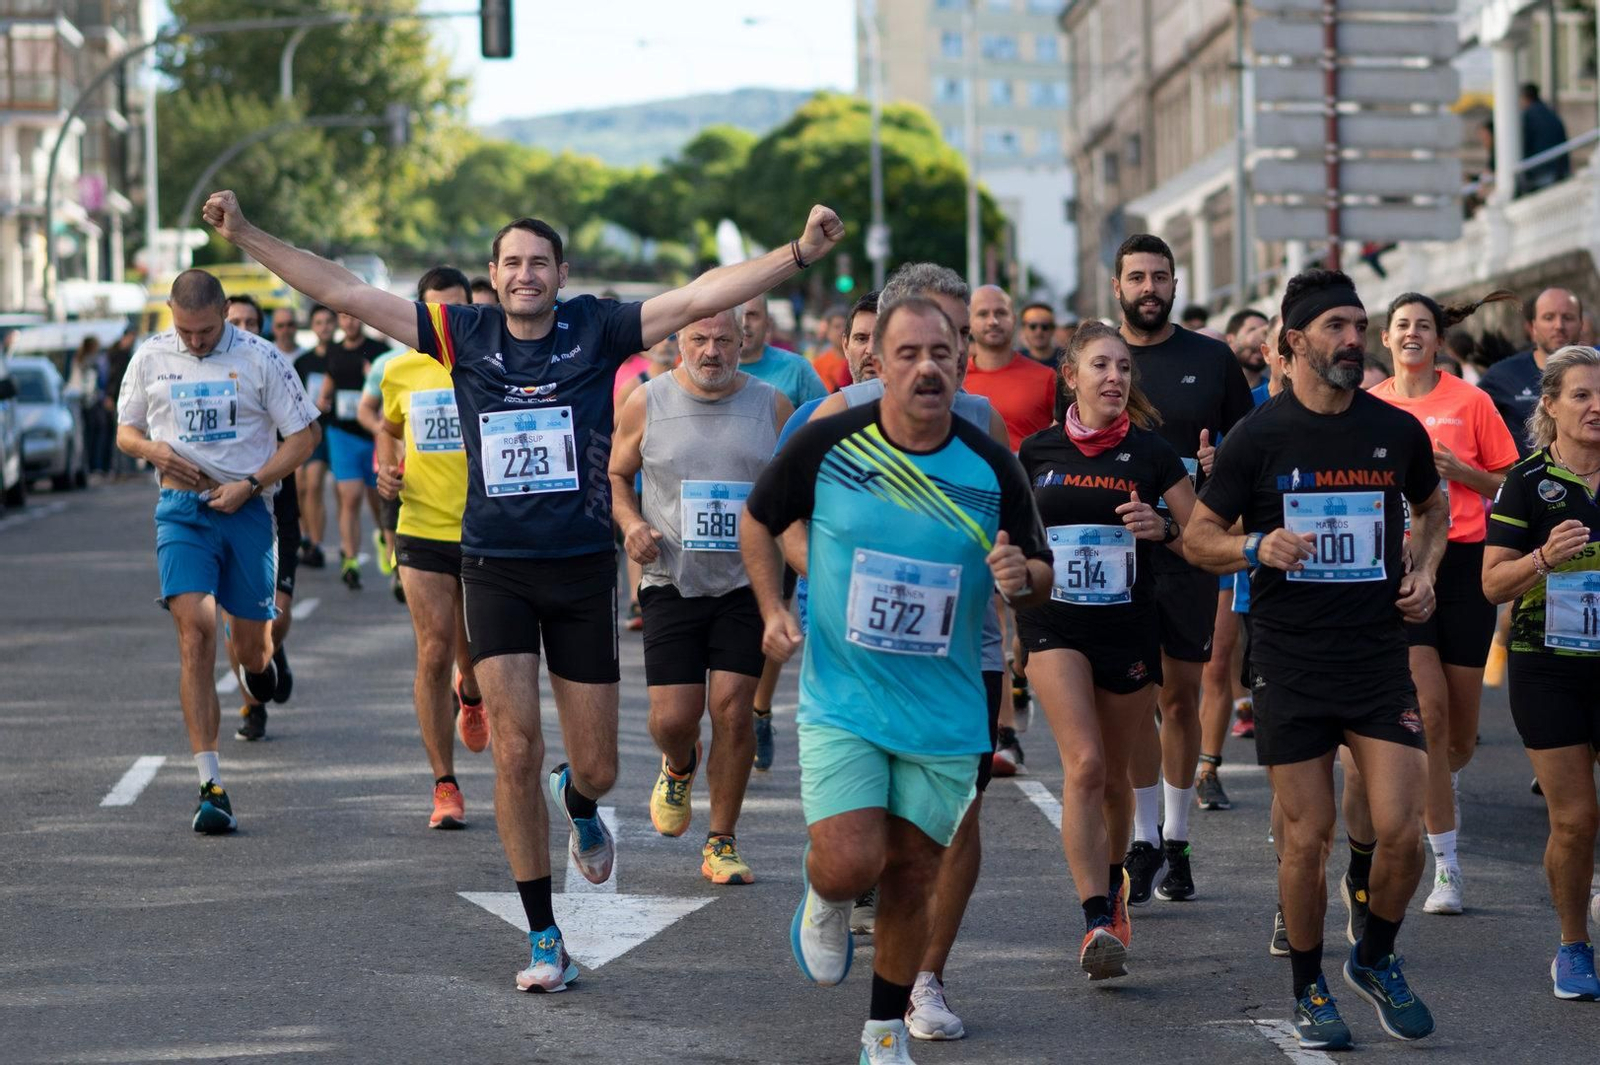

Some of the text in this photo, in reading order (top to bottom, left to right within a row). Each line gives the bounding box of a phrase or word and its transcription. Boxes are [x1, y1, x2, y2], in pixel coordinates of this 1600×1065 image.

[185, 408, 218, 432] 278
[425, 417, 461, 440] 285
[501, 446, 550, 478] 223
[696, 512, 737, 537] 589
[1315, 521, 1349, 529] MARCOS
[1067, 560, 1107, 589] 514
[868, 596, 925, 636] 572
